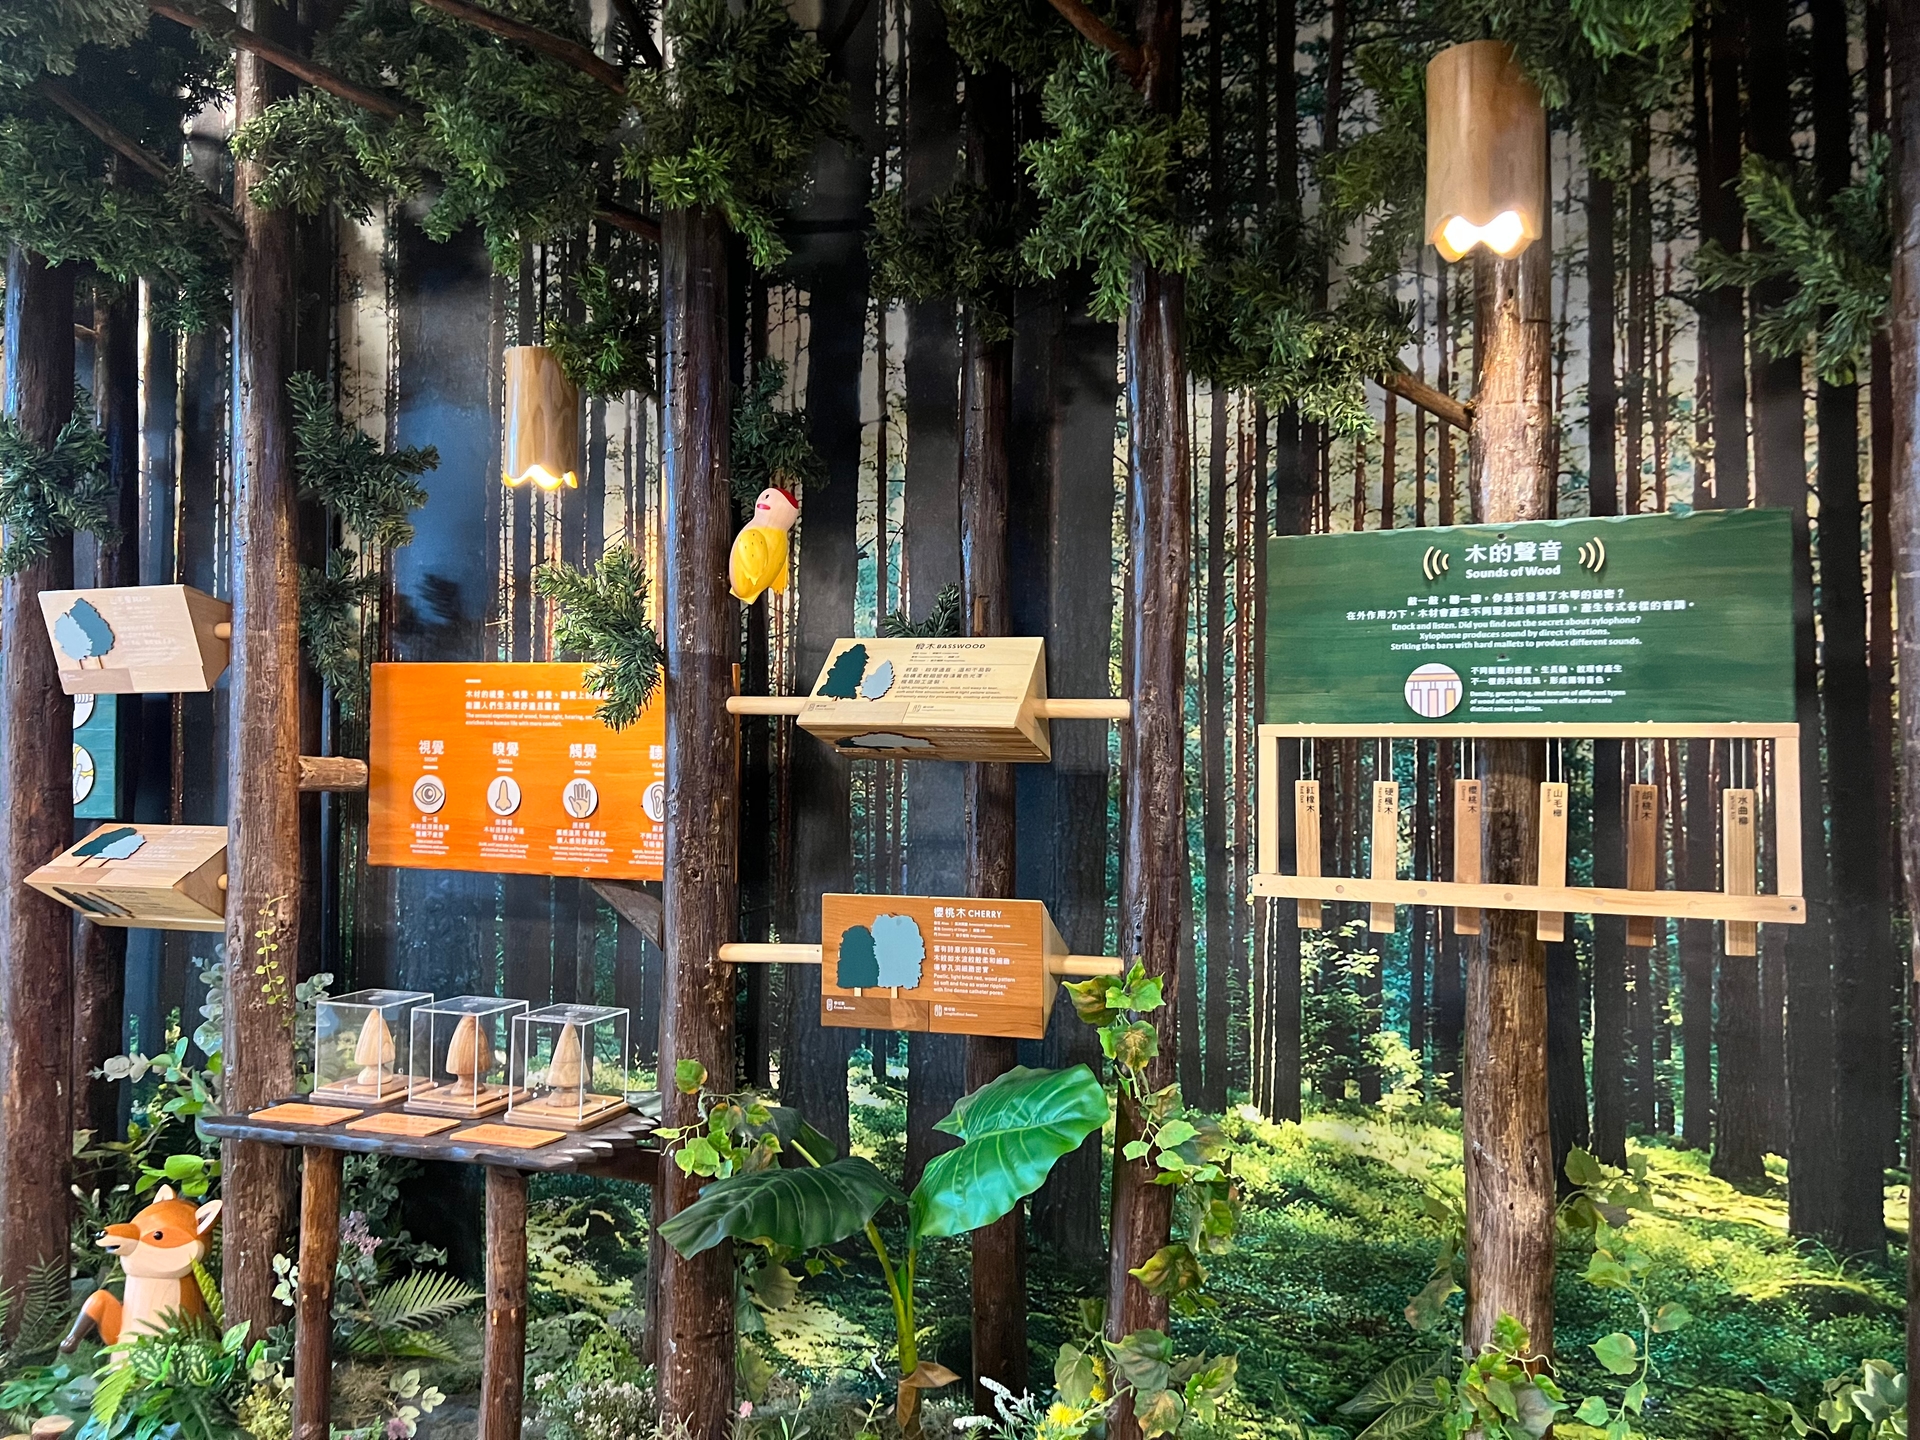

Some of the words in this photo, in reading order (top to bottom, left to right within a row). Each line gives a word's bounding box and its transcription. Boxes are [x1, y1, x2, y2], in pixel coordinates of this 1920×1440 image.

[1465, 540, 1562, 563] 木的聲音
[1466, 568, 1508, 579] Sounds
[1510, 566, 1524, 576] of
[1525, 565, 1560, 576] Wood
[1392, 622, 1414, 631] Knock
[1416, 622, 1430, 630] and
[1432, 621, 1456, 629] listen.
[1458, 621, 1471, 629] Did
[1473, 622, 1487, 630] you
[1489, 620, 1505, 628] find
[1507, 619, 1520, 627] out
[1522, 619, 1536, 627] the
[1538, 618, 1563, 627] secret
[1565, 617, 1589, 626] about
[1591, 616, 1641, 627] xylophone?
[1420, 632, 1460, 640] Xylophone
[1462, 631, 1499, 639] produces
[1527, 630, 1537, 638] by
[1390, 642, 1420, 652] Striking
[1422, 641, 1434, 649] the
[1436, 641, 1453, 649] bars
[1474, 640, 1492, 648] hard
[1494, 639, 1523, 647] mallets
[1535, 638, 1568, 648] product
[1570, 637, 1606, 645] different
[1608, 636, 1642, 645] sounds.
[419, 740, 444, 754] 視覺
[493, 742, 519, 756] 嗅覺
[570, 744, 596, 758] 觸覺
[1306, 786, 1315, 812] 紅橡木
[1385, 788, 1393, 814] 硬楓木
[1468, 786, 1477, 813] 櫻桃木
[1553, 789, 1562, 816] 山毛櫸
[1642, 791, 1652, 820] 胡桃木
[934, 907, 966, 918] 櫻桃木
[968, 910, 1002, 918] CHERRY
